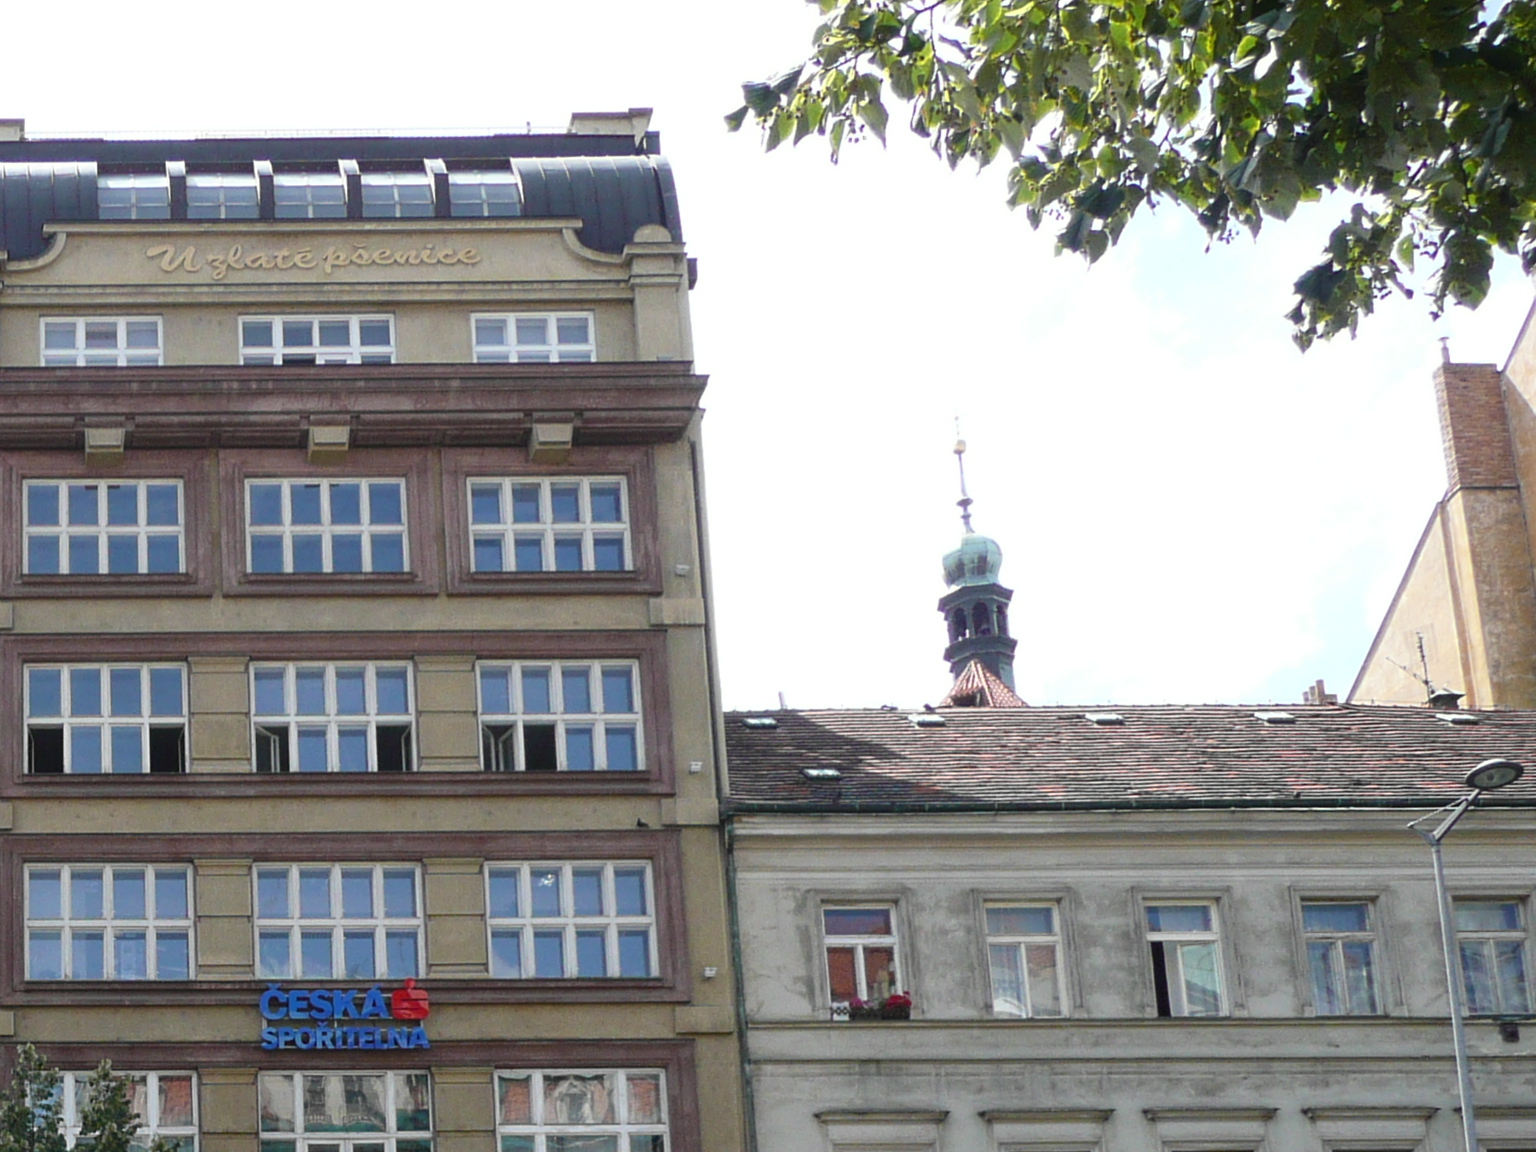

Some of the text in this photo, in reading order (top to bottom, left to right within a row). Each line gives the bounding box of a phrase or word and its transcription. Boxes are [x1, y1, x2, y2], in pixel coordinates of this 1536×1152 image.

[146, 243, 482, 280] U zlaté pšenice
[260, 982, 389, 1020] ČESKÁ
[261, 1021, 431, 1049] SPOŘITELNA
